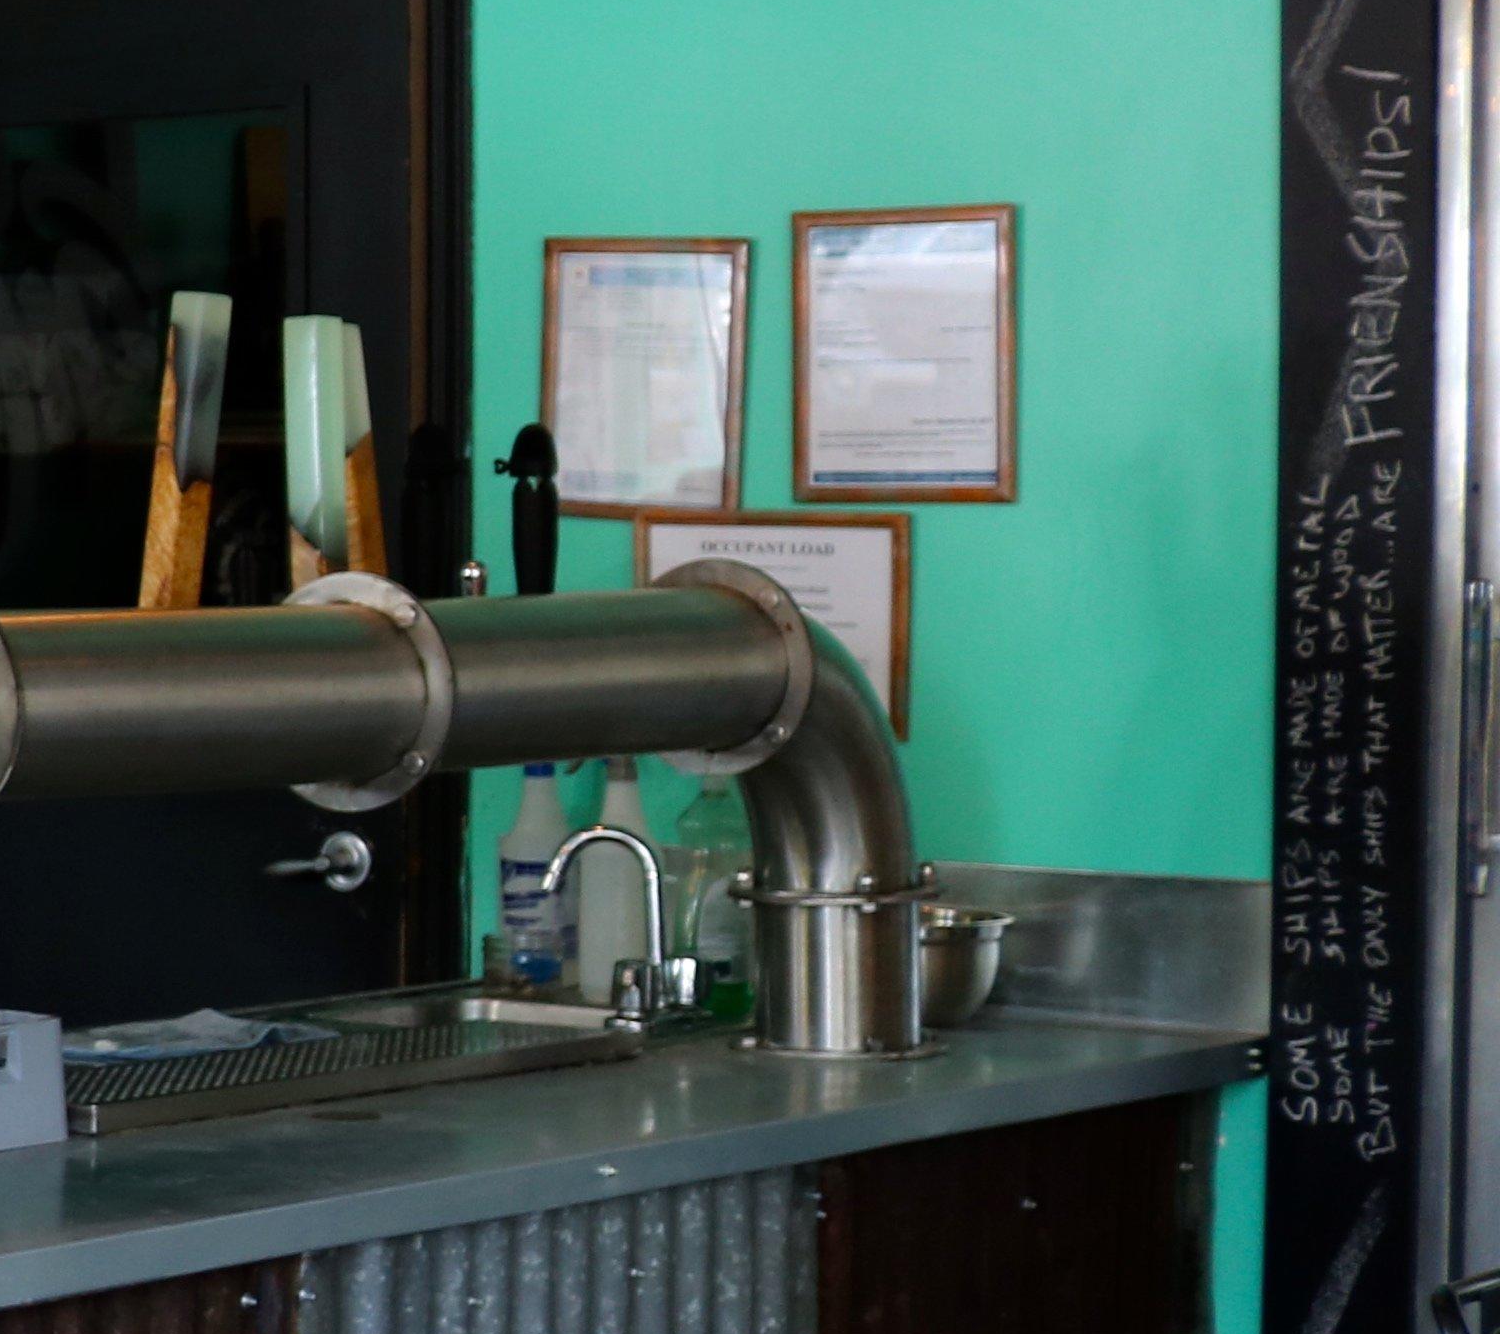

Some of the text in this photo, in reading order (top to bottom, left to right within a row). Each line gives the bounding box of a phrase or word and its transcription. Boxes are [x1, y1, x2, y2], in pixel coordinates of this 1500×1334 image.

[790, 541, 835, 556] LOAD
[1294, 473, 1330, 613] METAL
[1330, 494, 1361, 600] WOOD
[1295, 625, 1319, 659] OF
[1288, 672, 1318, 749] MADE
[1322, 671, 1345, 739] MADE
[1362, 694, 1391, 774] THAT
[1283, 837, 1316, 965] SHIPS
[1319, 848, 1346, 964] SHIPS
[1280, 1003, 1319, 1125] SOME
[1328, 1024, 1354, 1124] SOME
[1357, 1069, 1397, 1163] BUT
